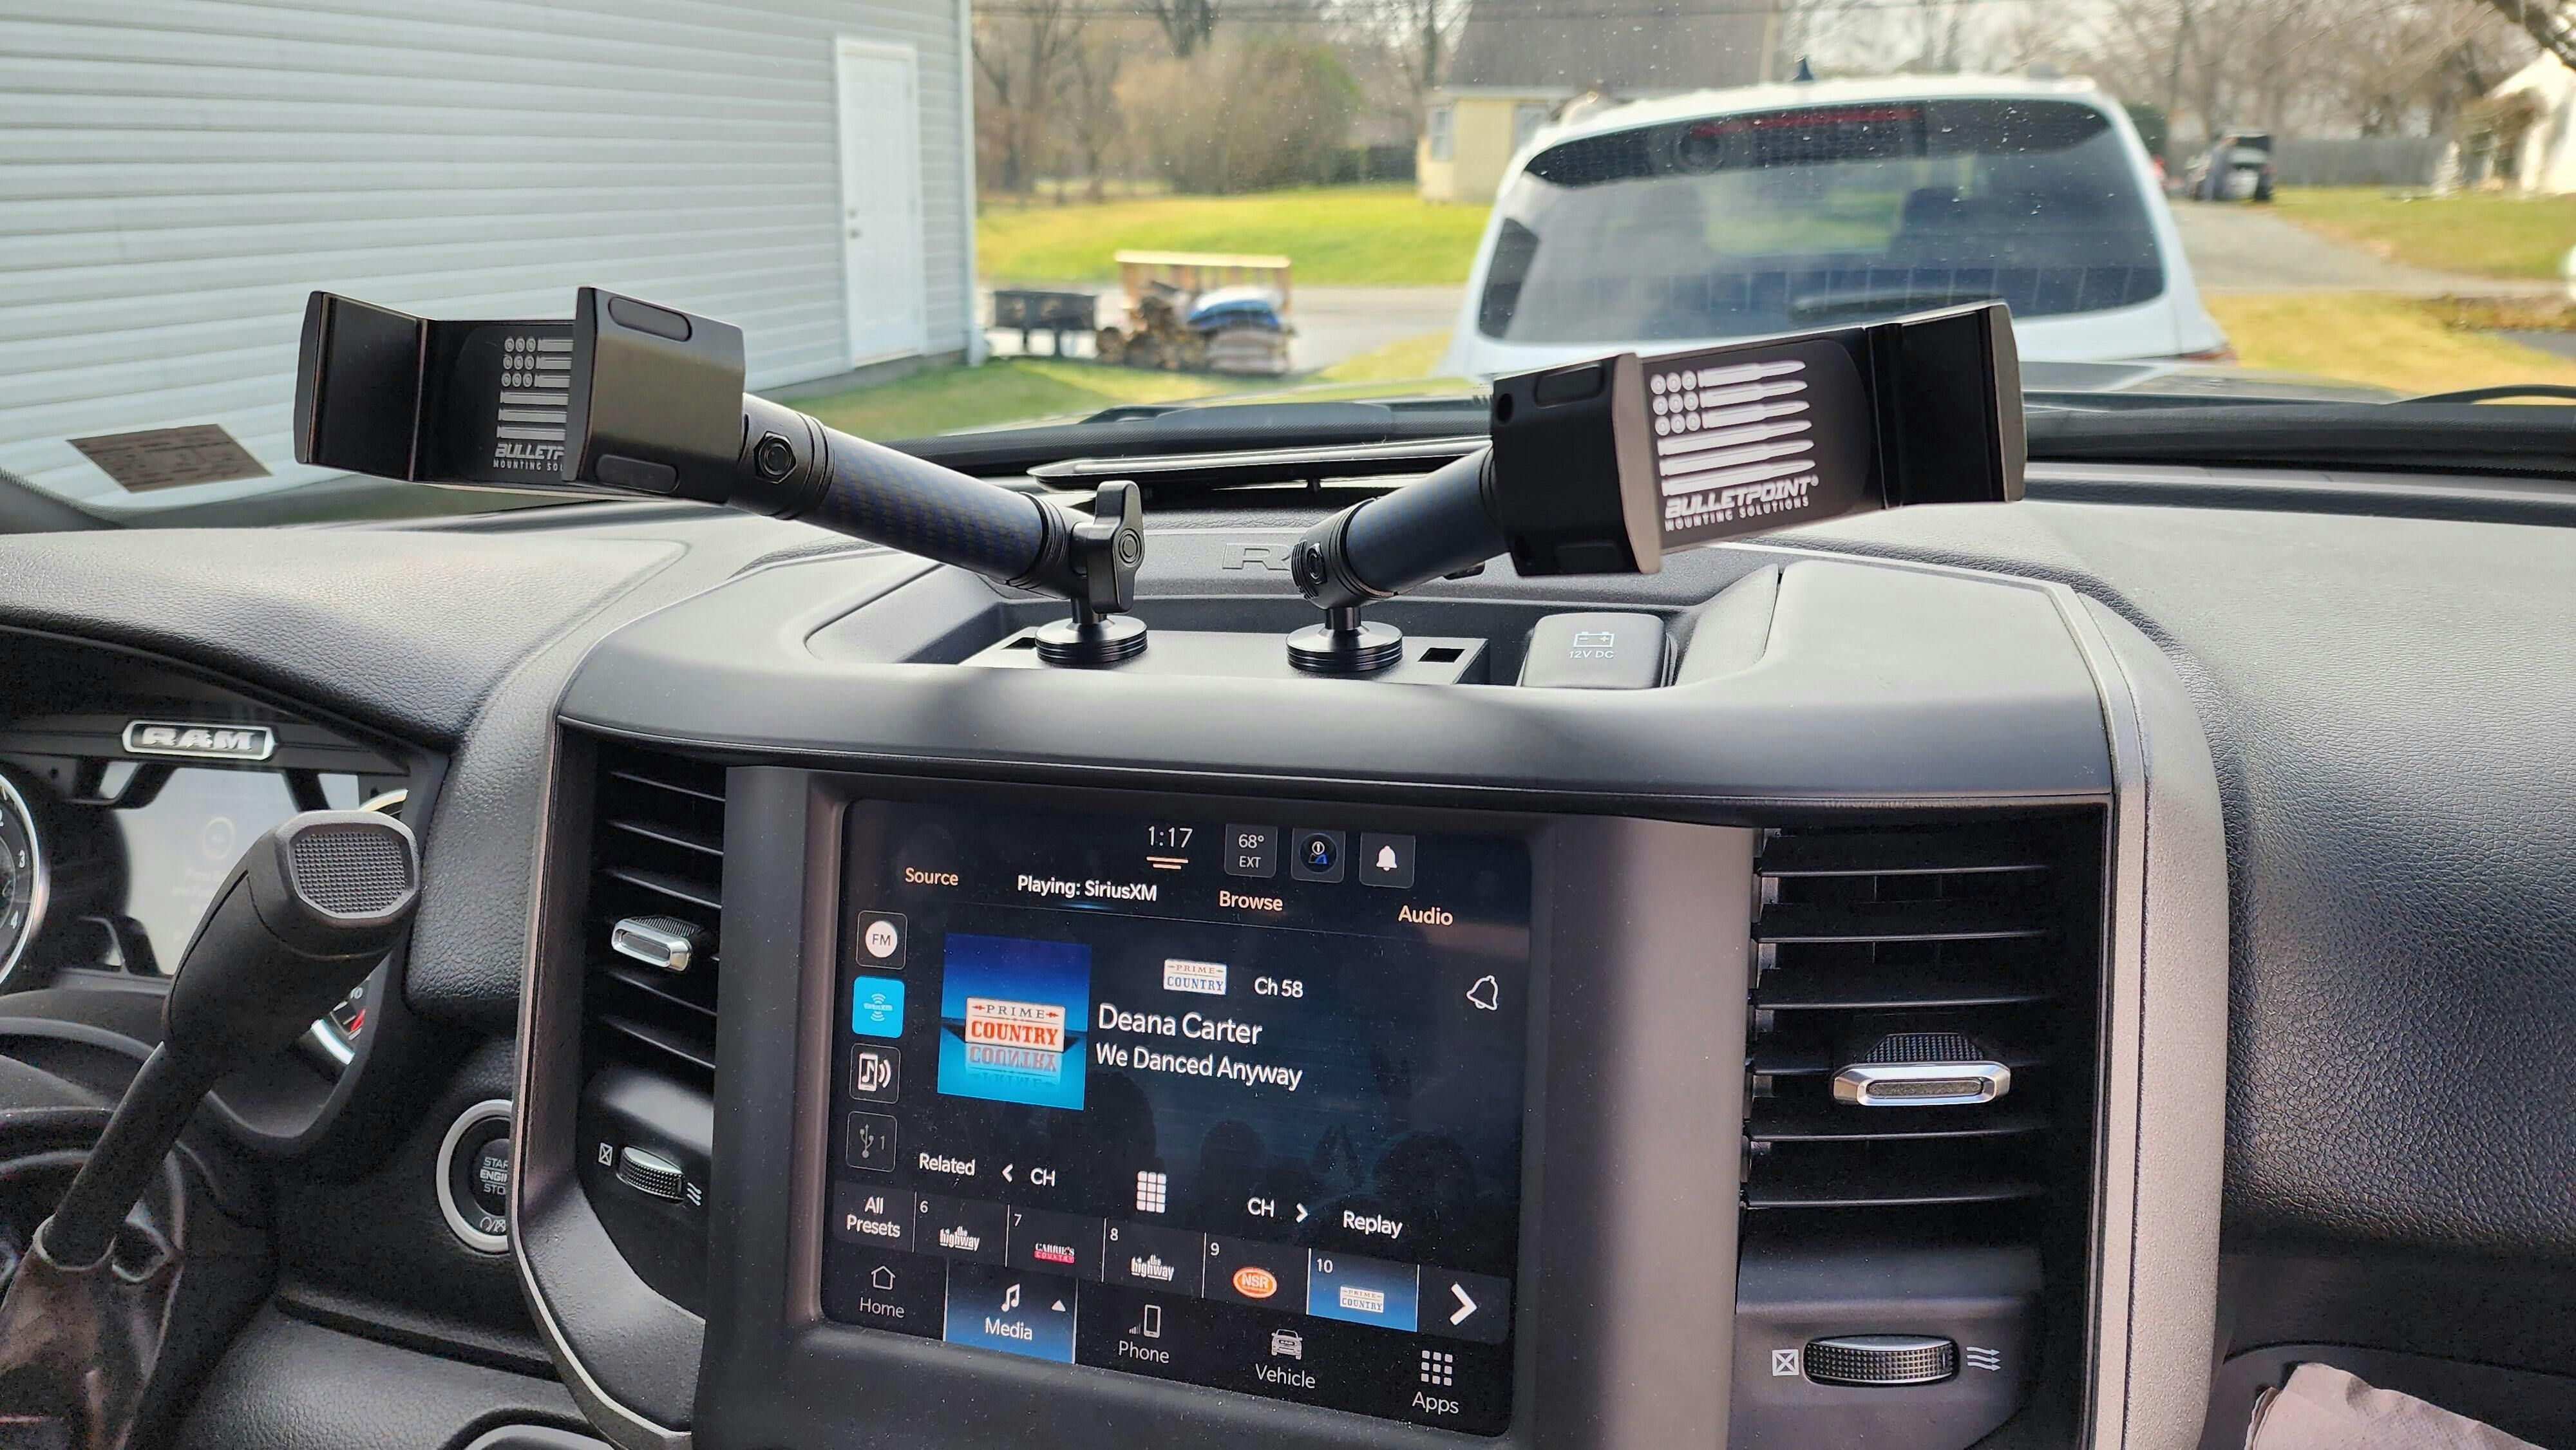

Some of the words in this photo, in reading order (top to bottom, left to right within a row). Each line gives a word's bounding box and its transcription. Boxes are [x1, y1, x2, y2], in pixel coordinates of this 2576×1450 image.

[493, 458, 542, 471] MOUNTING
[1665, 508, 1733, 532] MOUNTING
[1739, 494, 1809, 519] SOLUTIONS
[1569, 650, 1592, 659] 12V
[1595, 650, 1615, 659] DC
[142, 726, 256, 751] RAM
[1148, 825, 1193, 849] 1:17
[1238, 834, 1265, 849] 68°
[19, 850, 26, 868] 3
[1239, 856, 1262, 869] EXT
[904, 867, 959, 887] Source
[1018, 874, 1081, 898] Playing:
[1084, 880, 1157, 902] SiriusXM
[1218, 890, 1283, 912] Browse
[10, 910, 19, 929] 4
[1398, 905, 1454, 926] Audio
[872, 934, 891, 946] FM
[1177, 965, 1215, 974] PRIME
[1167, 976, 1224, 992] COUNTRY
[1255, 976, 1278, 996] Ch
[1281, 979, 1304, 998] 58
[985, 1004, 1045, 1019] PRIME
[971, 1020, 1059, 1046] COUNTRY
[1098, 1003, 1177, 1037] Deana
[1182, 1012, 1263, 1045] Carter
[1096, 1042, 1128, 1068] We
[1133, 1046, 1213, 1077] Danced
[1217, 1055, 1303, 1091] Anyway
[880, 1135, 885, 1150] 1
[919, 1152, 976, 1176] Related
[1030, 1167, 1056, 1187] CH
[864, 1196, 884, 1215] All
[920, 1200, 929, 1214] 6
[1247, 1197, 1274, 1218] CH
[846, 1214, 901, 1238] Presets
[1014, 1214, 1022, 1227] 7
[1343, 1210, 1403, 1239] Replay
[940, 1228, 980, 1252] highway
[1110, 1228, 1119, 1241] 8
[1210, 1242, 1220, 1256] 9
[1131, 1256, 1175, 1281] highway
[1150, 1254, 1162, 1266] the
[1317, 1258, 1333, 1274] 10
[1242, 1273, 1269, 1288] NSR
[1342, 1297, 1383, 1311] COUNTRY
[1349, 1290, 1376, 1298] PRIME
[860, 1297, 905, 1319] Home
[985, 1317, 1032, 1341] Media
[1119, 1340, 1170, 1364] Phone
[1255, 1364, 1316, 1389] Vehicle
[1412, 1391, 1460, 1415] Apps
